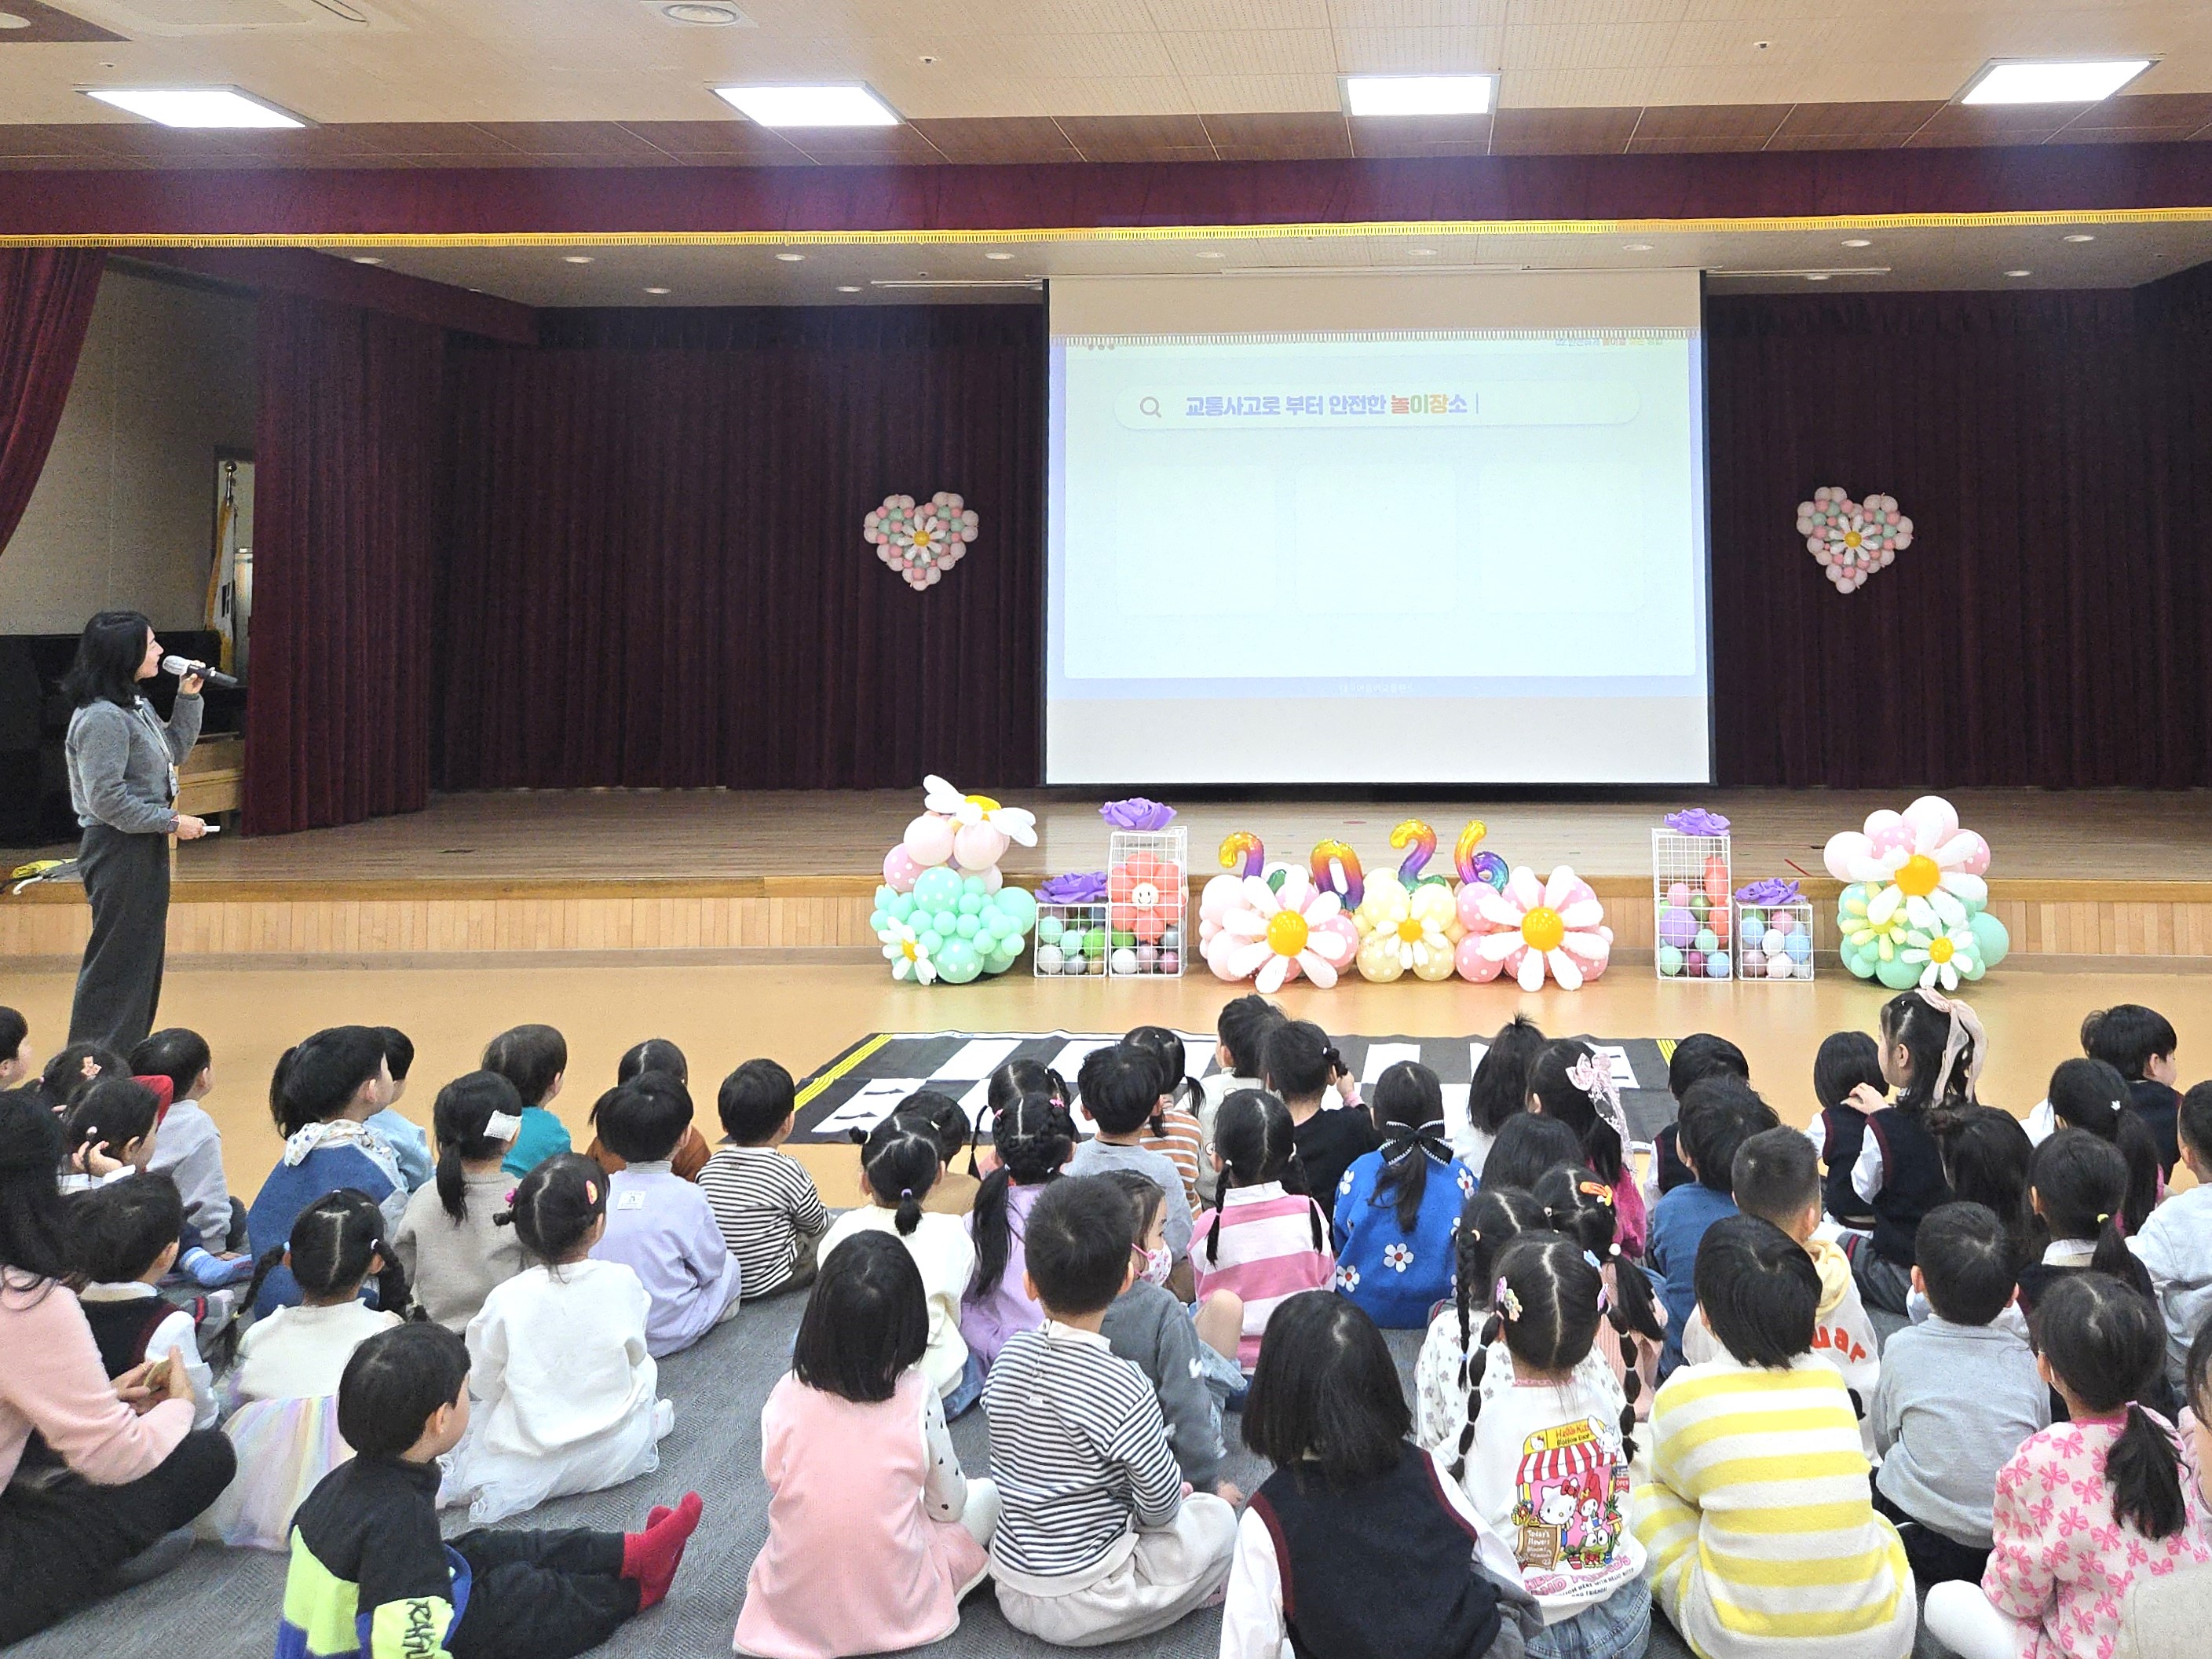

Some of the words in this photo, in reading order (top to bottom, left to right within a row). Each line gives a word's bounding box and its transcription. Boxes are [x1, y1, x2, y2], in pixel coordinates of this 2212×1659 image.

[1185, 395, 1281, 417] 교통사고로
[1285, 394, 1325, 416] 부터
[1328, 393, 1387, 415] 안전한
[1390, 393, 1468, 415] 놀이장소
